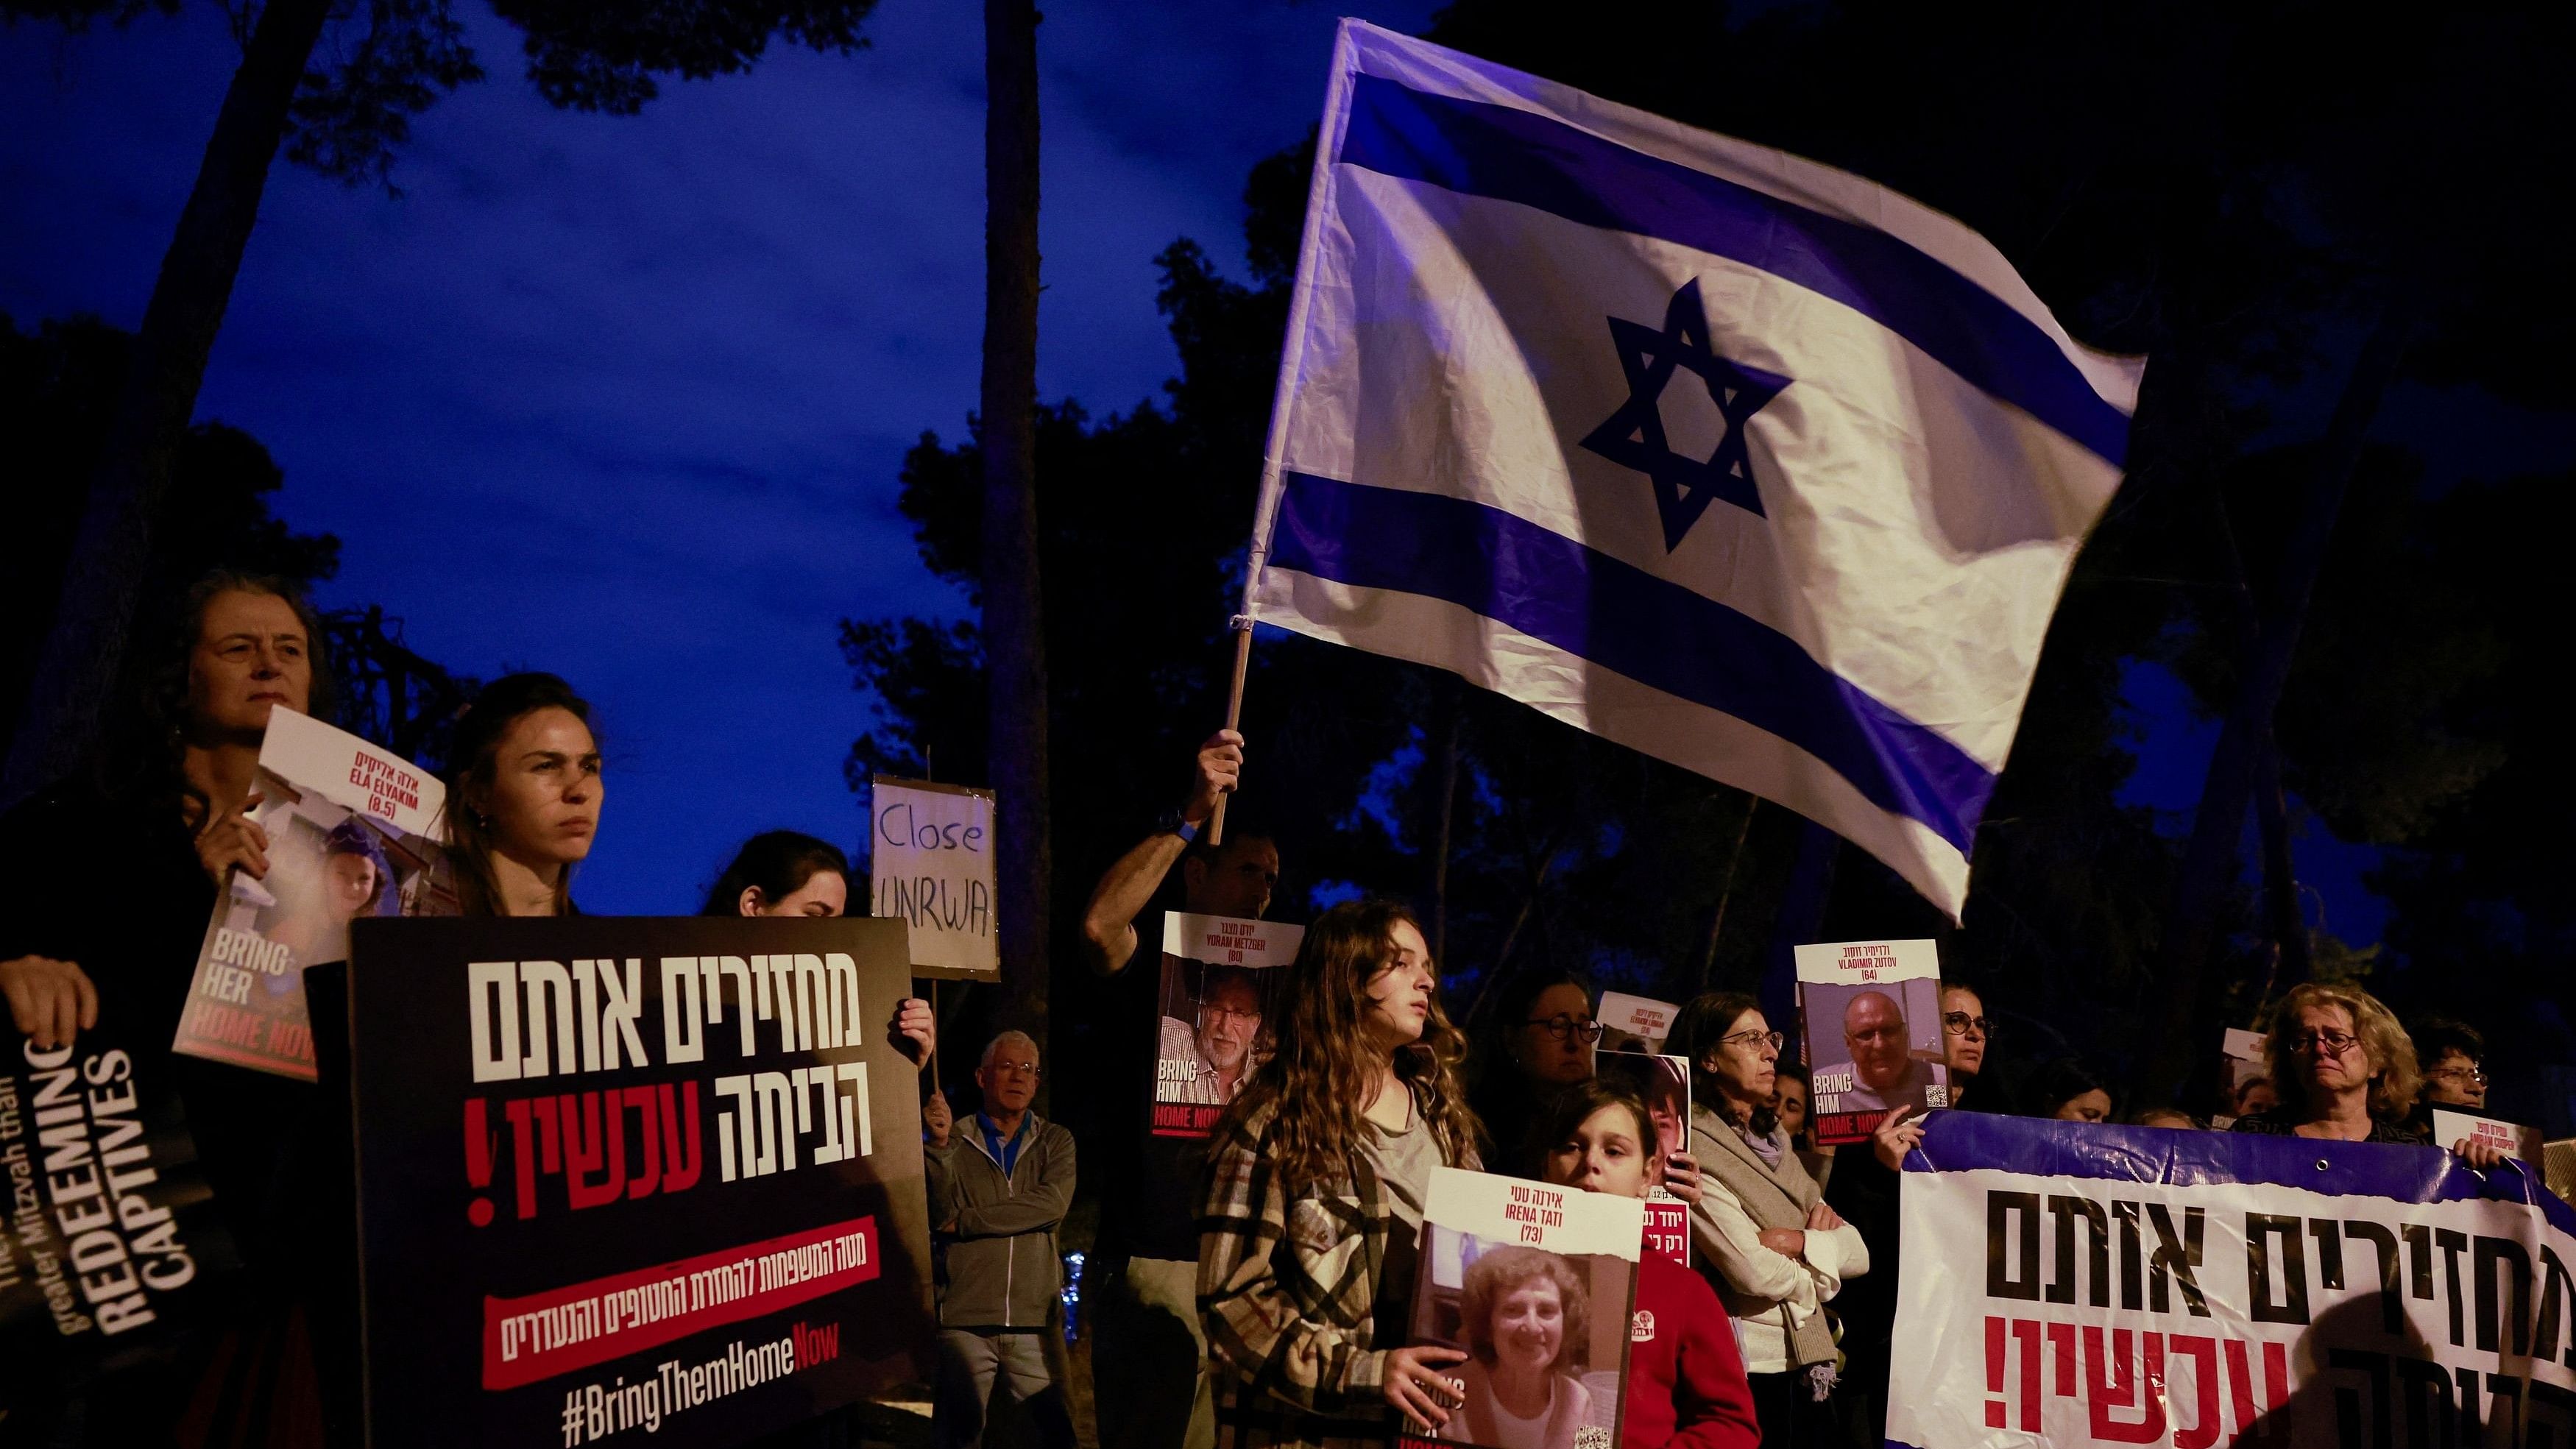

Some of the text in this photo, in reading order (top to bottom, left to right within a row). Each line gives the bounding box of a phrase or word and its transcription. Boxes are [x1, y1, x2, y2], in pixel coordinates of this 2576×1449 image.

[350, 768, 418, 810] ELA ELYAKIM
[355, 751, 419, 793] אלה אליקים
[368, 793, 395, 820] (8.5)
[880, 803, 983, 852] Close
[882, 876, 988, 937] UNRWA
[211, 927, 289, 976] BRING
[1206, 934, 1265, 951] YORAM METZGER
[1228, 949, 1242, 963] (80)
[1839, 957, 1897, 970] VLADIMIR ZUTOV
[1861, 969, 1878, 981] (64)
[201, 962, 254, 1005] HER
[189, 1001, 265, 1049] HOME
[467, 952, 862, 1083] מחזירים אותם
[1158, 1059, 1197, 1083] BRING
[1813, 1073, 1853, 1094] BRING
[1156, 1080, 1181, 1103] HIM
[1814, 1094, 1841, 1115] HIM
[1154, 1105, 1191, 1127] HOME
[1816, 1115, 1855, 1136] HOME
[462, 1061, 873, 1229] הביתה עכשיו!
[83, 1048, 197, 1292] CAPTIVES
[0, 1142, 49, 1247] Mitzvah
[1511, 1186, 1563, 1209] אירנה טטי
[1505, 1203, 1563, 1227] IRENA TATI
[1658, 1211, 1682, 1227] יחד
[1521, 1224, 1543, 1245] (73)
[1666, 1234, 1683, 1253] רק
[31, 1250, 94, 1336] greater
[1986, 1189, 2576, 1371] מחזירים אותם
[500, 1232, 868, 1363] מטה המשפחות להחזרת החטופים והנעדרים
[561, 1319, 840, 1449] #BringThemHomeNow
[1984, 1315, 2290, 1449] עכשיו!
